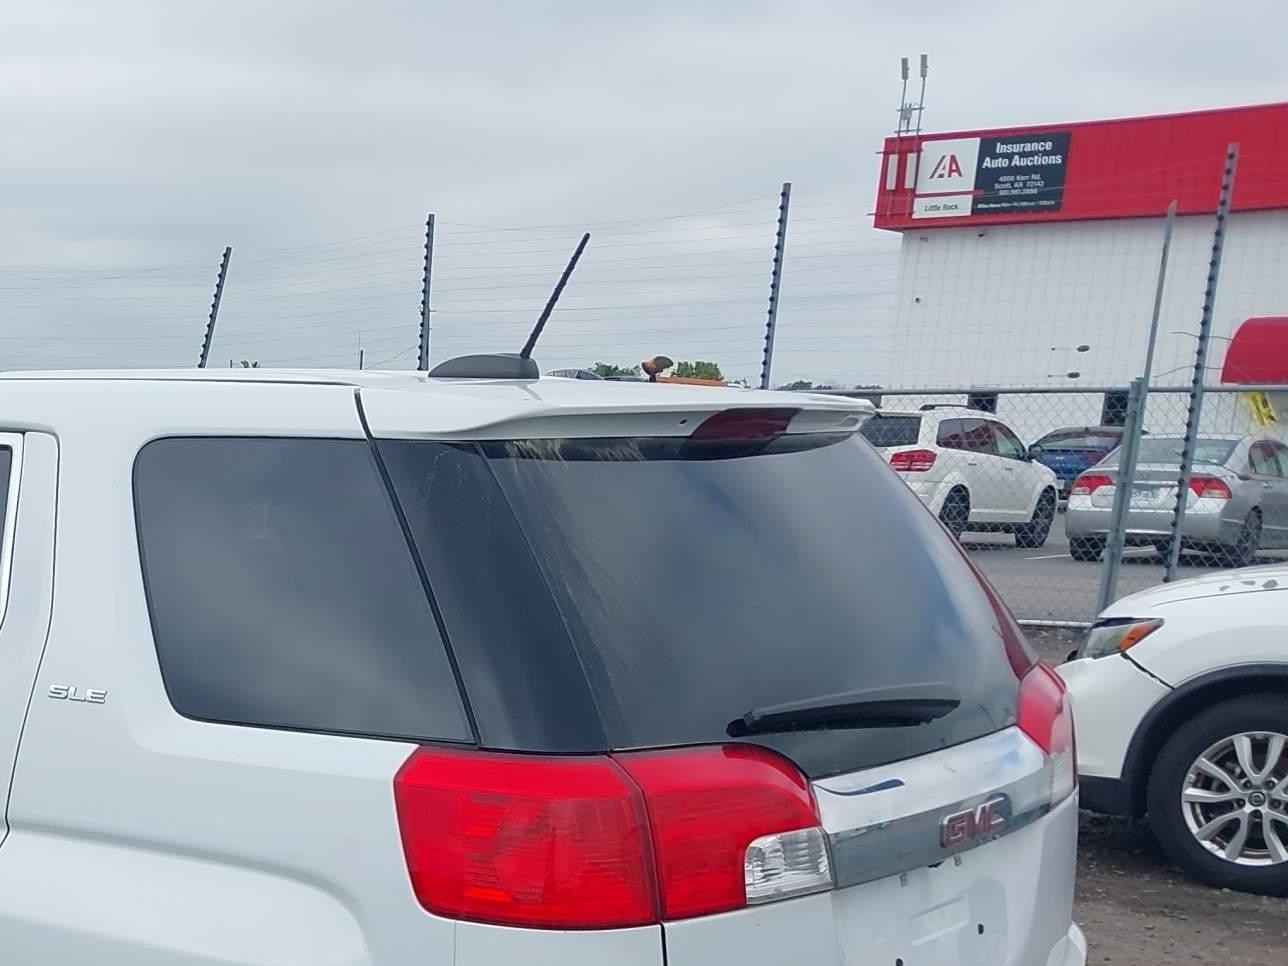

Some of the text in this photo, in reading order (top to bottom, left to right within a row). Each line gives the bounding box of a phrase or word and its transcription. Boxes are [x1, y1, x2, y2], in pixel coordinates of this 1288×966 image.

[996, 141, 1053, 154] Insurance
[982, 153, 1063, 169] Auto Auctions
[48, 684, 108, 704] SLE
[940, 797, 1006, 848] GMC
